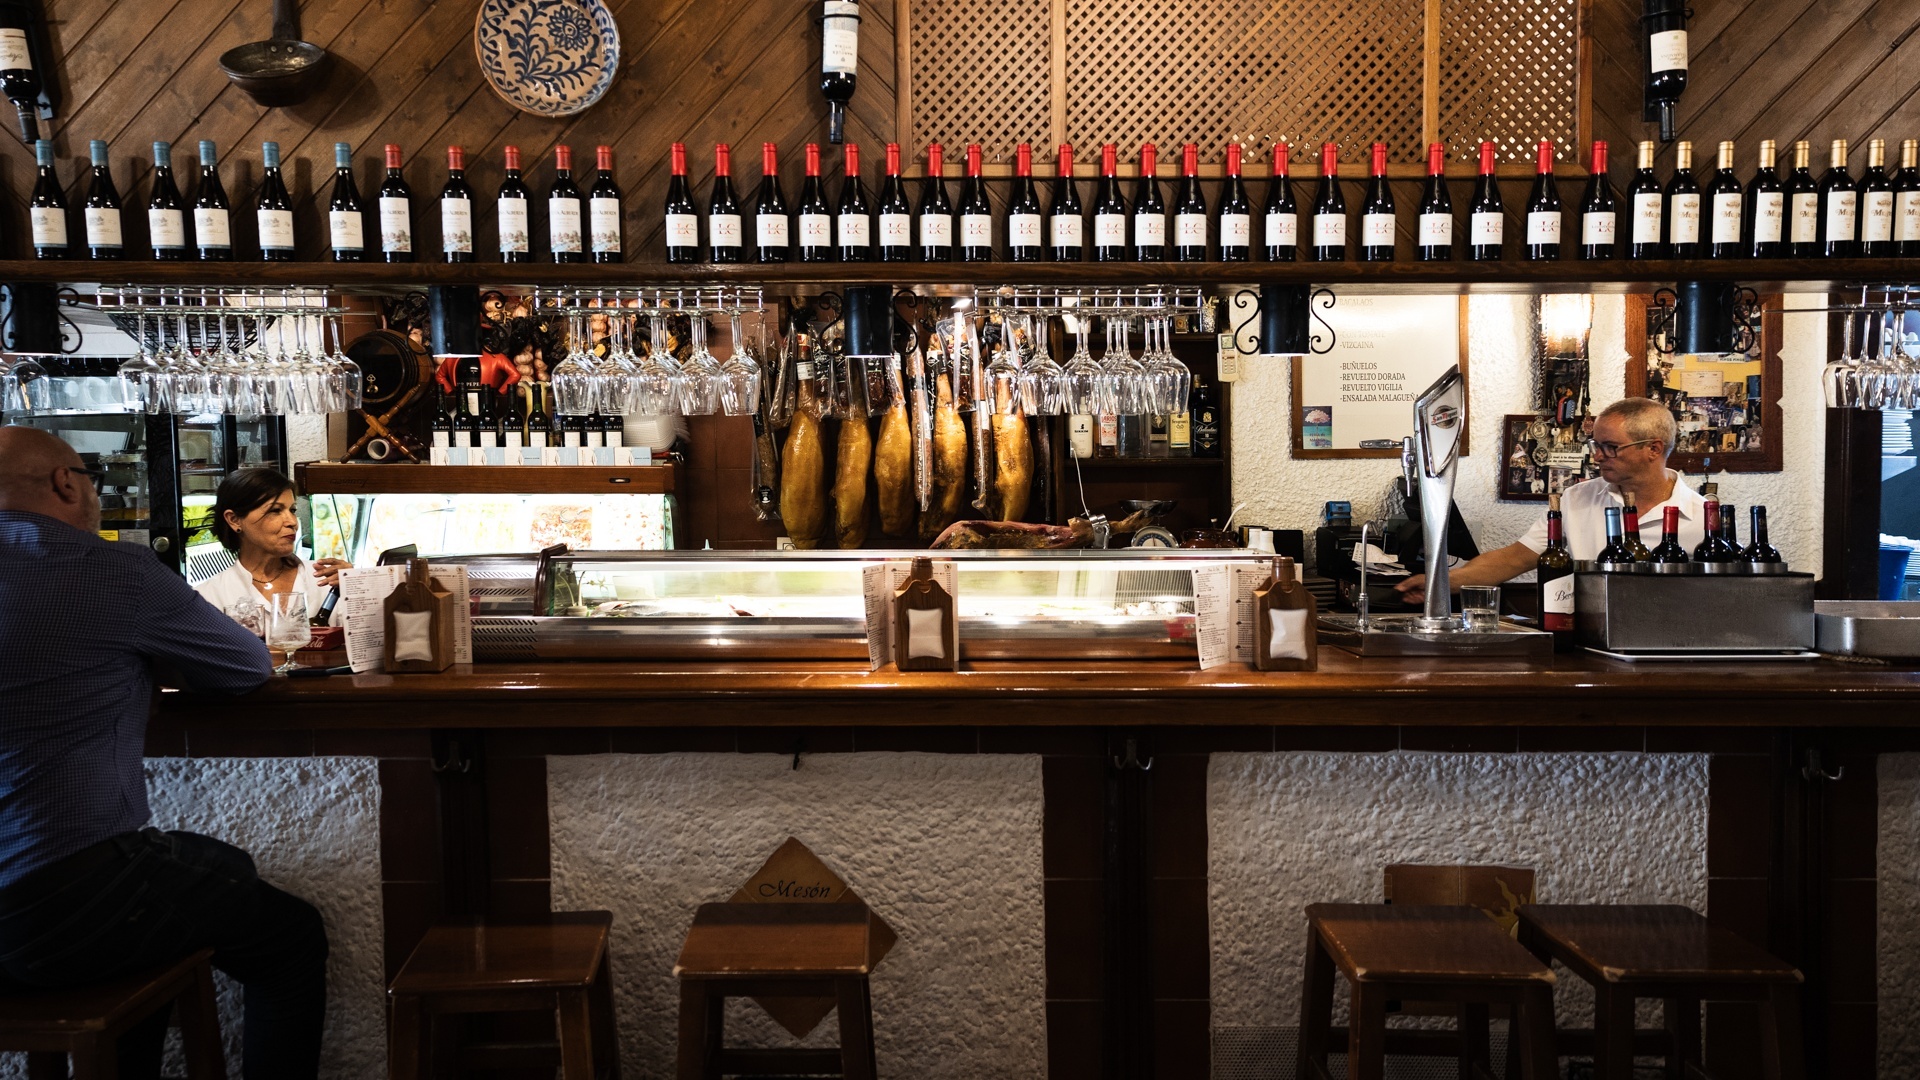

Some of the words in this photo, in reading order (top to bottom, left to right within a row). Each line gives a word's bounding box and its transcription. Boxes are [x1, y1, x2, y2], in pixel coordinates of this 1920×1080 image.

[1339, 361, 1378, 370] -BUÑUELOS
[1339, 373, 1377, 381] -REVUELTO
[1378, 373, 1406, 381] DORADA
[1339, 383, 1377, 392] -REVUELTO
[1378, 383, 1403, 391] VIGILIA
[1339, 394, 1377, 402] -ENSALADA
[759, 880, 831, 898] Mesón
